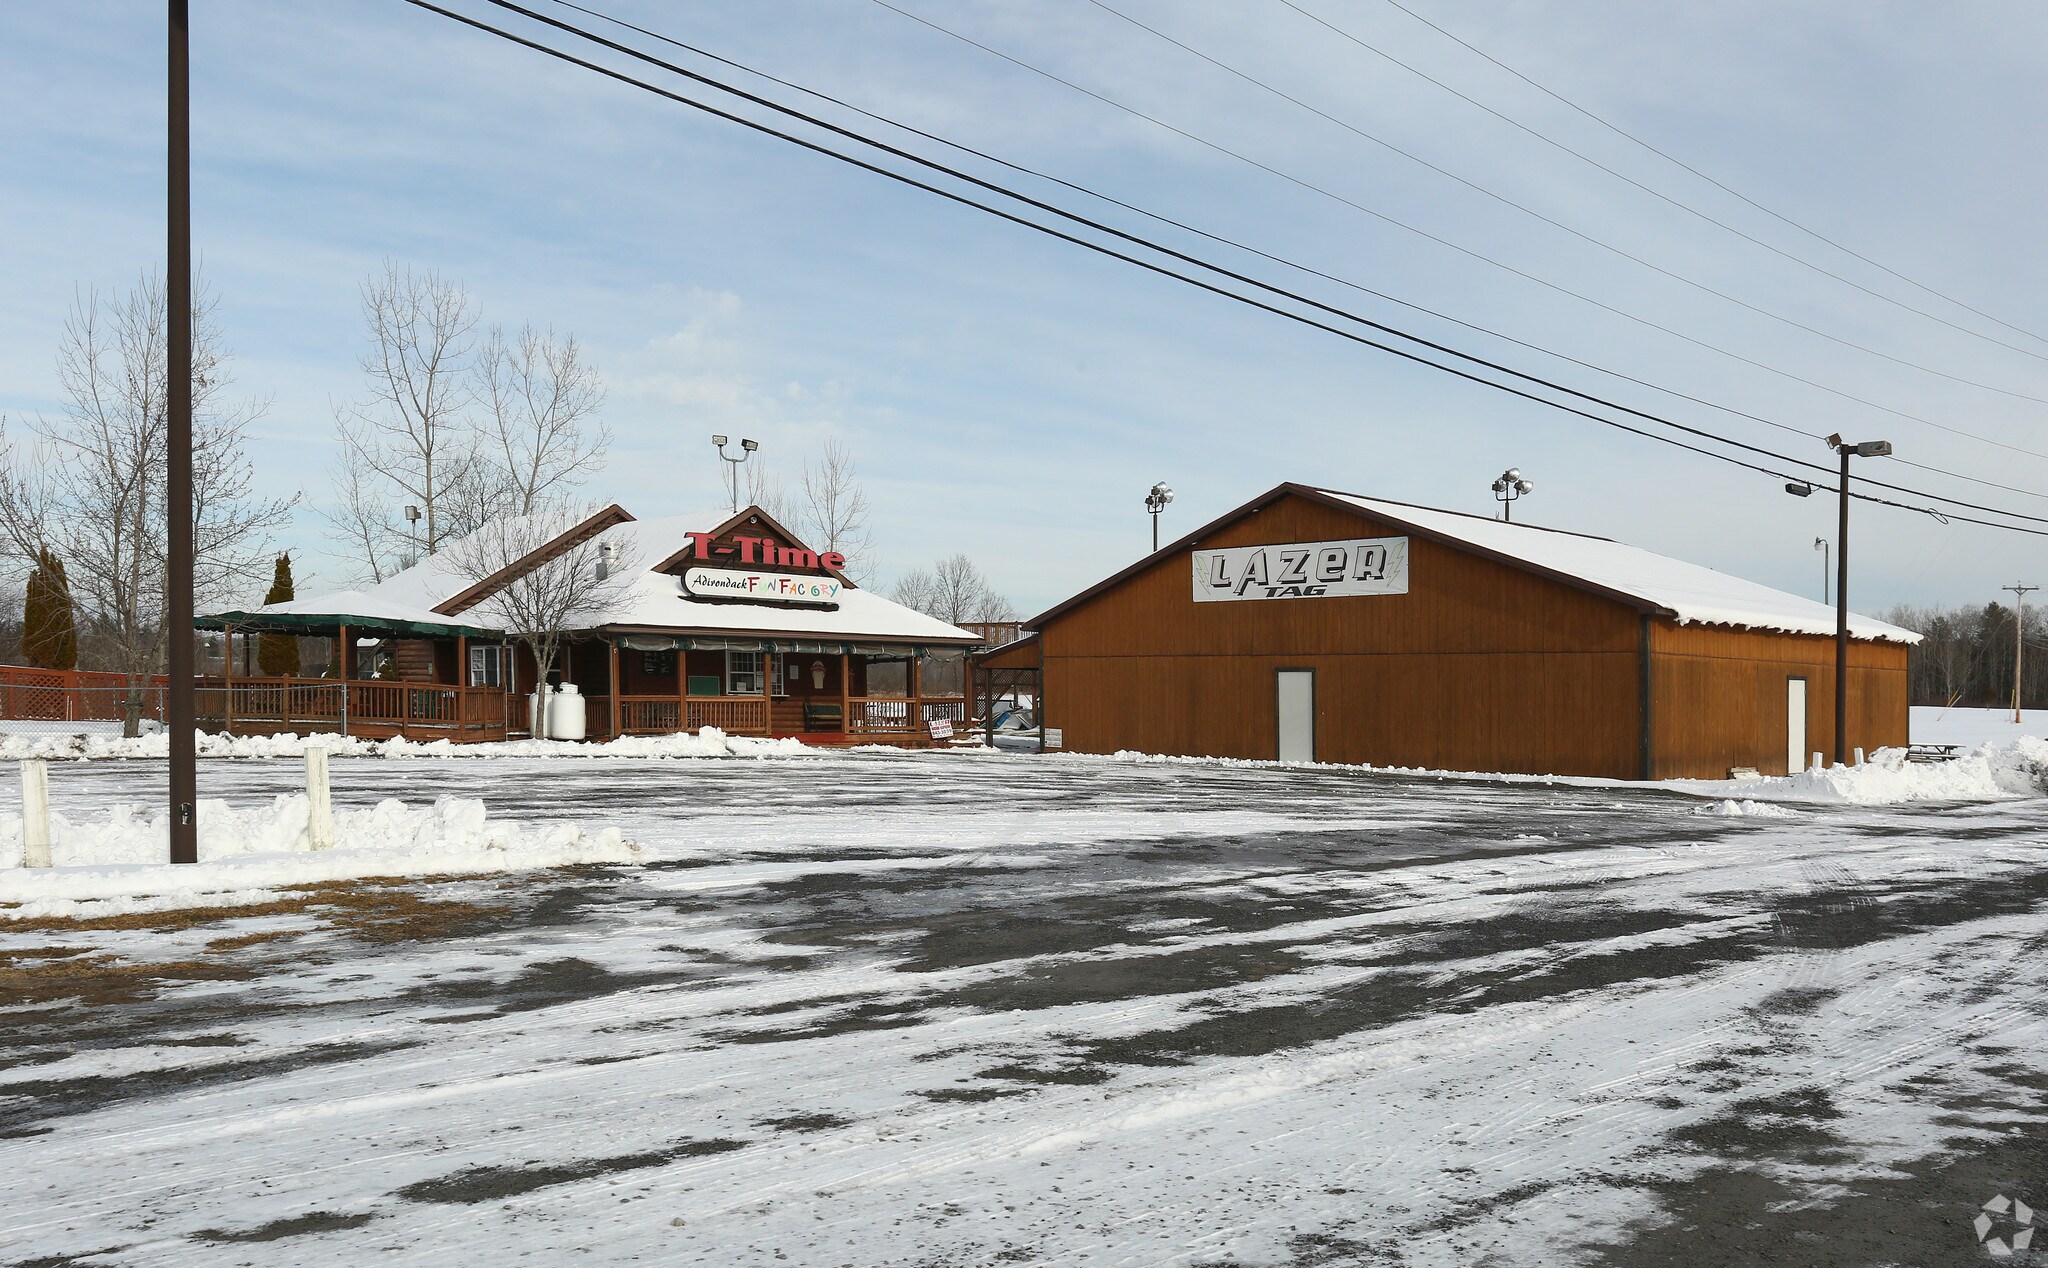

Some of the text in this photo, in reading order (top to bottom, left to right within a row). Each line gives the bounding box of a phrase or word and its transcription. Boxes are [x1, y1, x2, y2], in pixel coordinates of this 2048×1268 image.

[684, 532, 846, 570] T-Time
[691, 574, 748, 590] Adirondack
[1264, 584, 1328, 598] TAG
